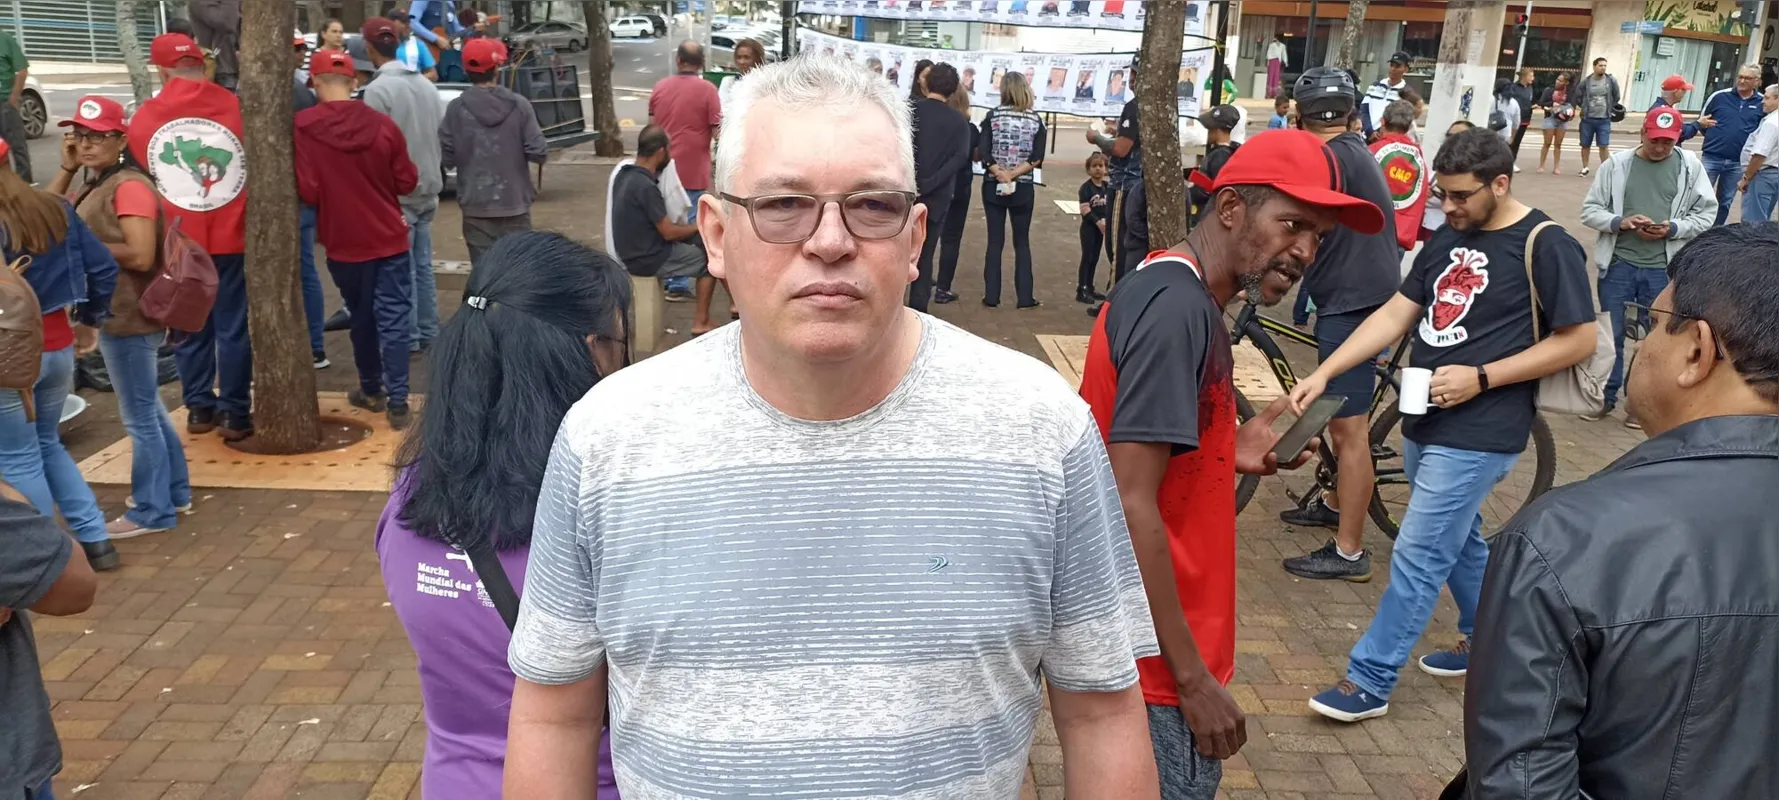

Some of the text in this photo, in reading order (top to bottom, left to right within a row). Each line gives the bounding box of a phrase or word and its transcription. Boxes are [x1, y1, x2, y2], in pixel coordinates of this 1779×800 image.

[418, 562, 450, 577] Marcha
[417, 572, 472, 591] Mundial das
[417, 583, 459, 598] Mulheres
